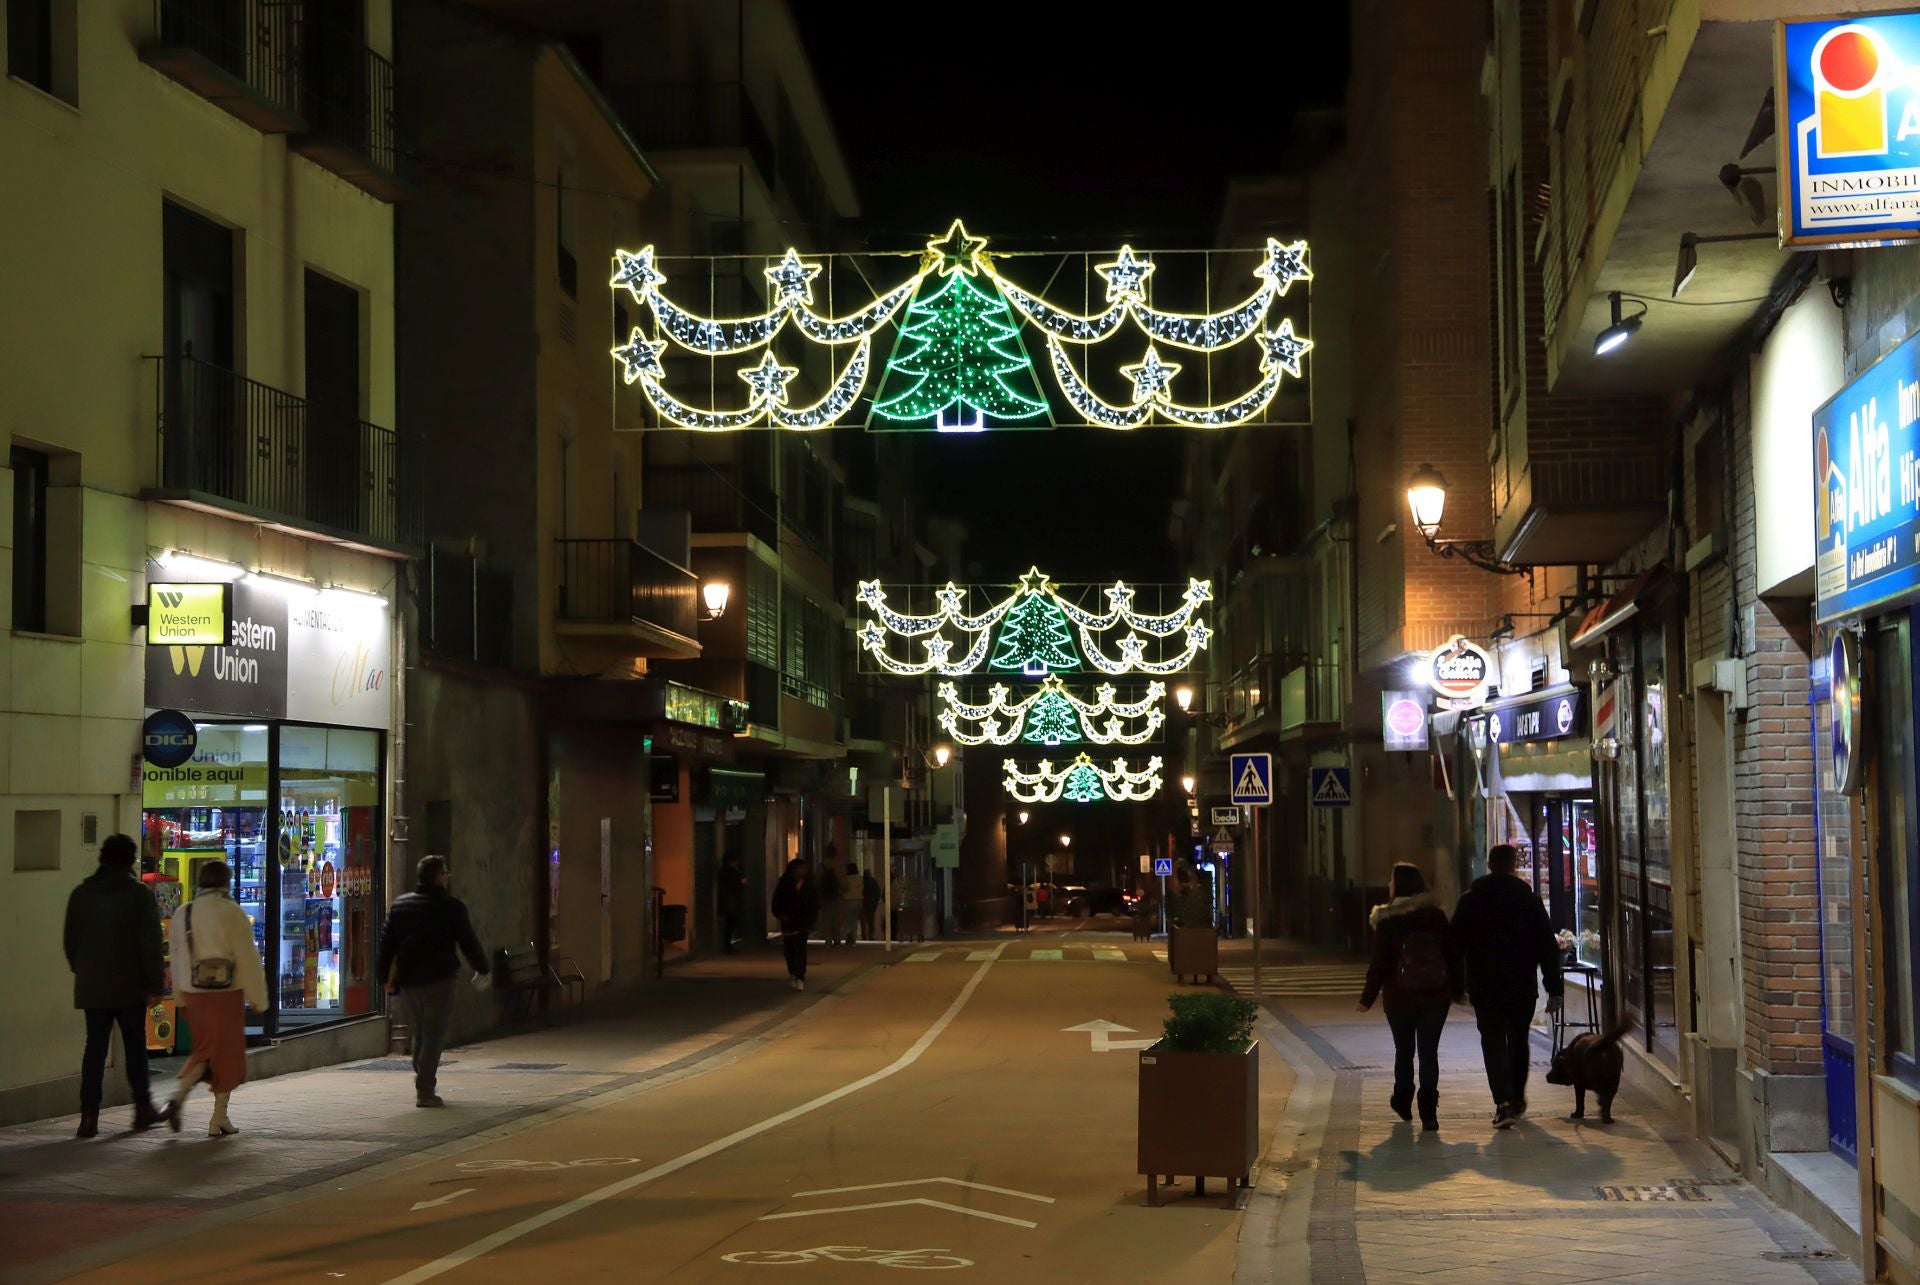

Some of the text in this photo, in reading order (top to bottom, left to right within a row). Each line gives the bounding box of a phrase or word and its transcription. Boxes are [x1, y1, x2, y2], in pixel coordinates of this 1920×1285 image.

[1849, 396, 1891, 532] Alfa
[160, 613, 211, 625] Western
[159, 626, 196, 637] Union
[231, 616, 276, 652] estern
[213, 645, 259, 684] Union
[145, 734, 194, 746] DIGI
